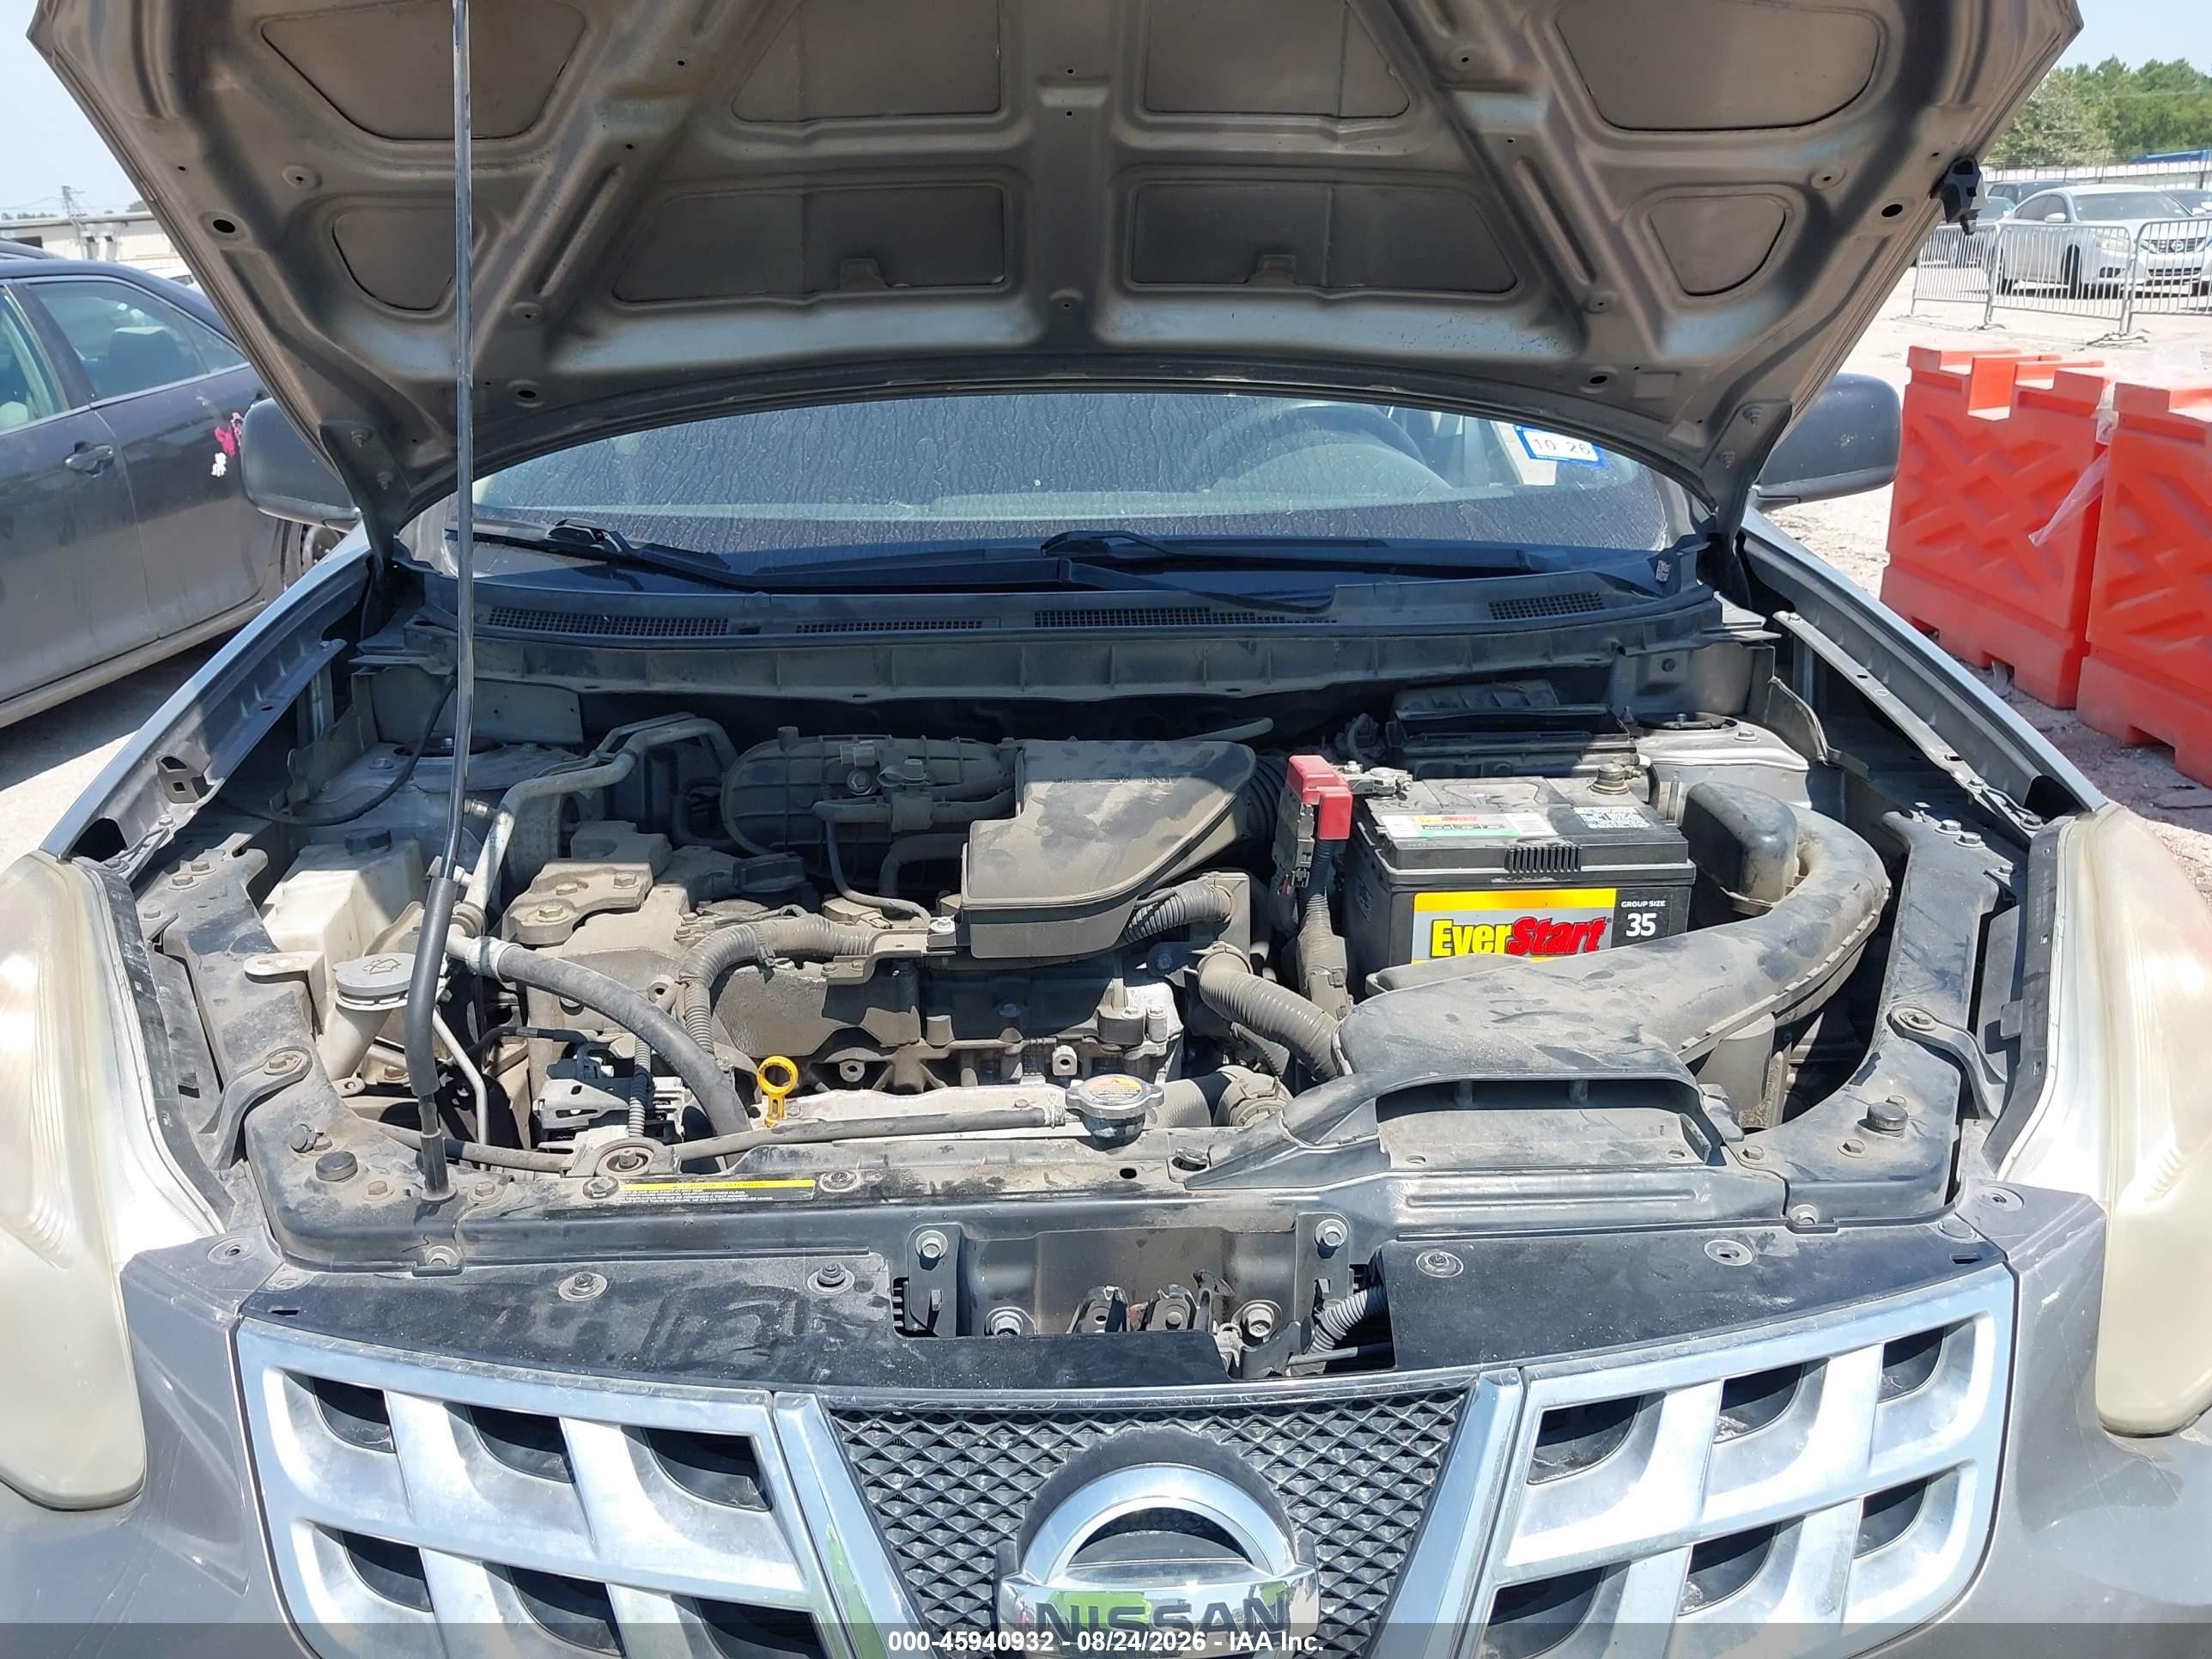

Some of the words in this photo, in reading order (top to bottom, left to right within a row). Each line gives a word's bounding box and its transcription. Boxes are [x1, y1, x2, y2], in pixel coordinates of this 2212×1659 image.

[1533, 439, 1556, 451] 10
[1565, 441, 1590, 454] 26
[1431, 916, 1607, 957] EverStart
[1626, 912, 1657, 937] 35
[1035, 1590, 1288, 1644] NISSAN
